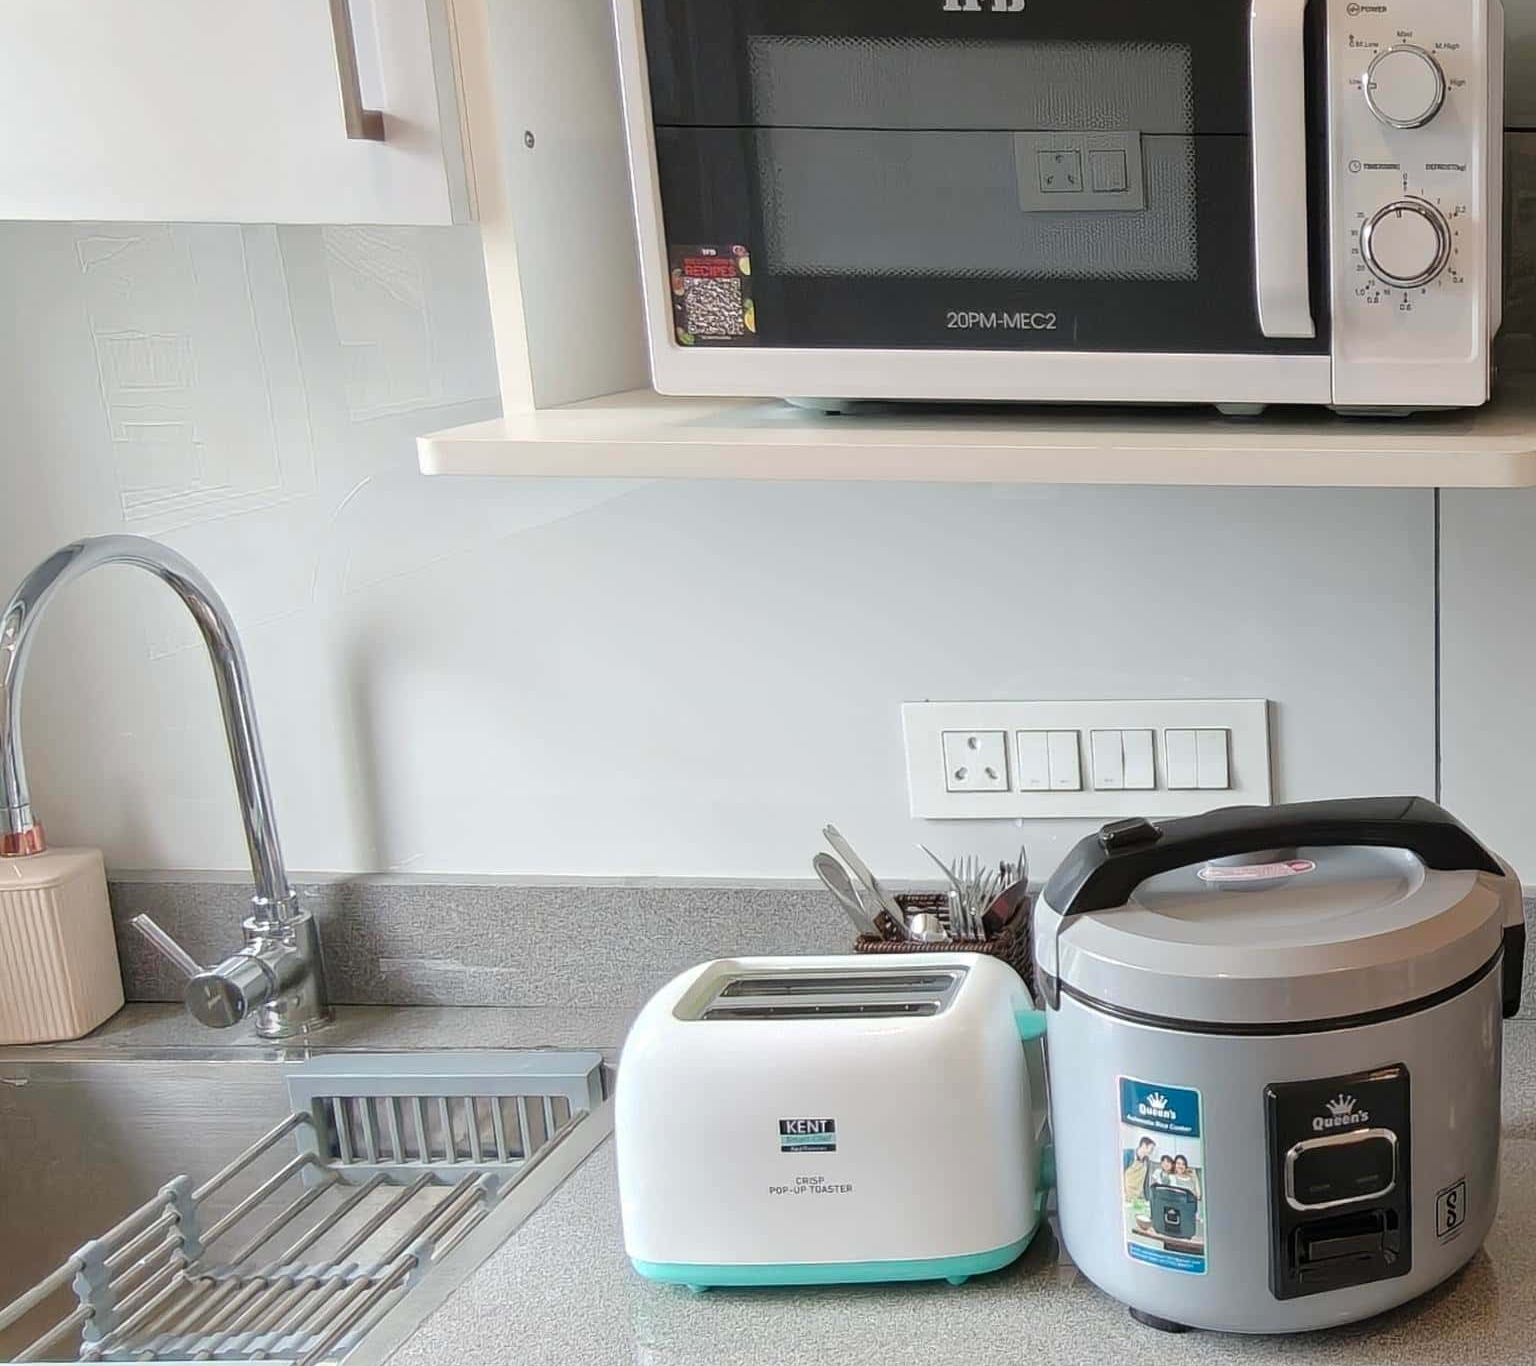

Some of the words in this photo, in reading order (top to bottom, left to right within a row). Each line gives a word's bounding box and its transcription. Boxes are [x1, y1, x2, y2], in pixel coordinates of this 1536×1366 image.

[684, 266, 736, 276] RECIPES
[947, 311, 1057, 329] 20PM-MEC2
[1138, 1102, 1177, 1120] Queen's
[786, 1120, 828, 1134] KENT
[1312, 1110, 1369, 1131] Queen's
[795, 1176, 825, 1185] CRISP
[769, 1185, 807, 1195] POP-UP
[810, 1183, 853, 1194] TOASTER
